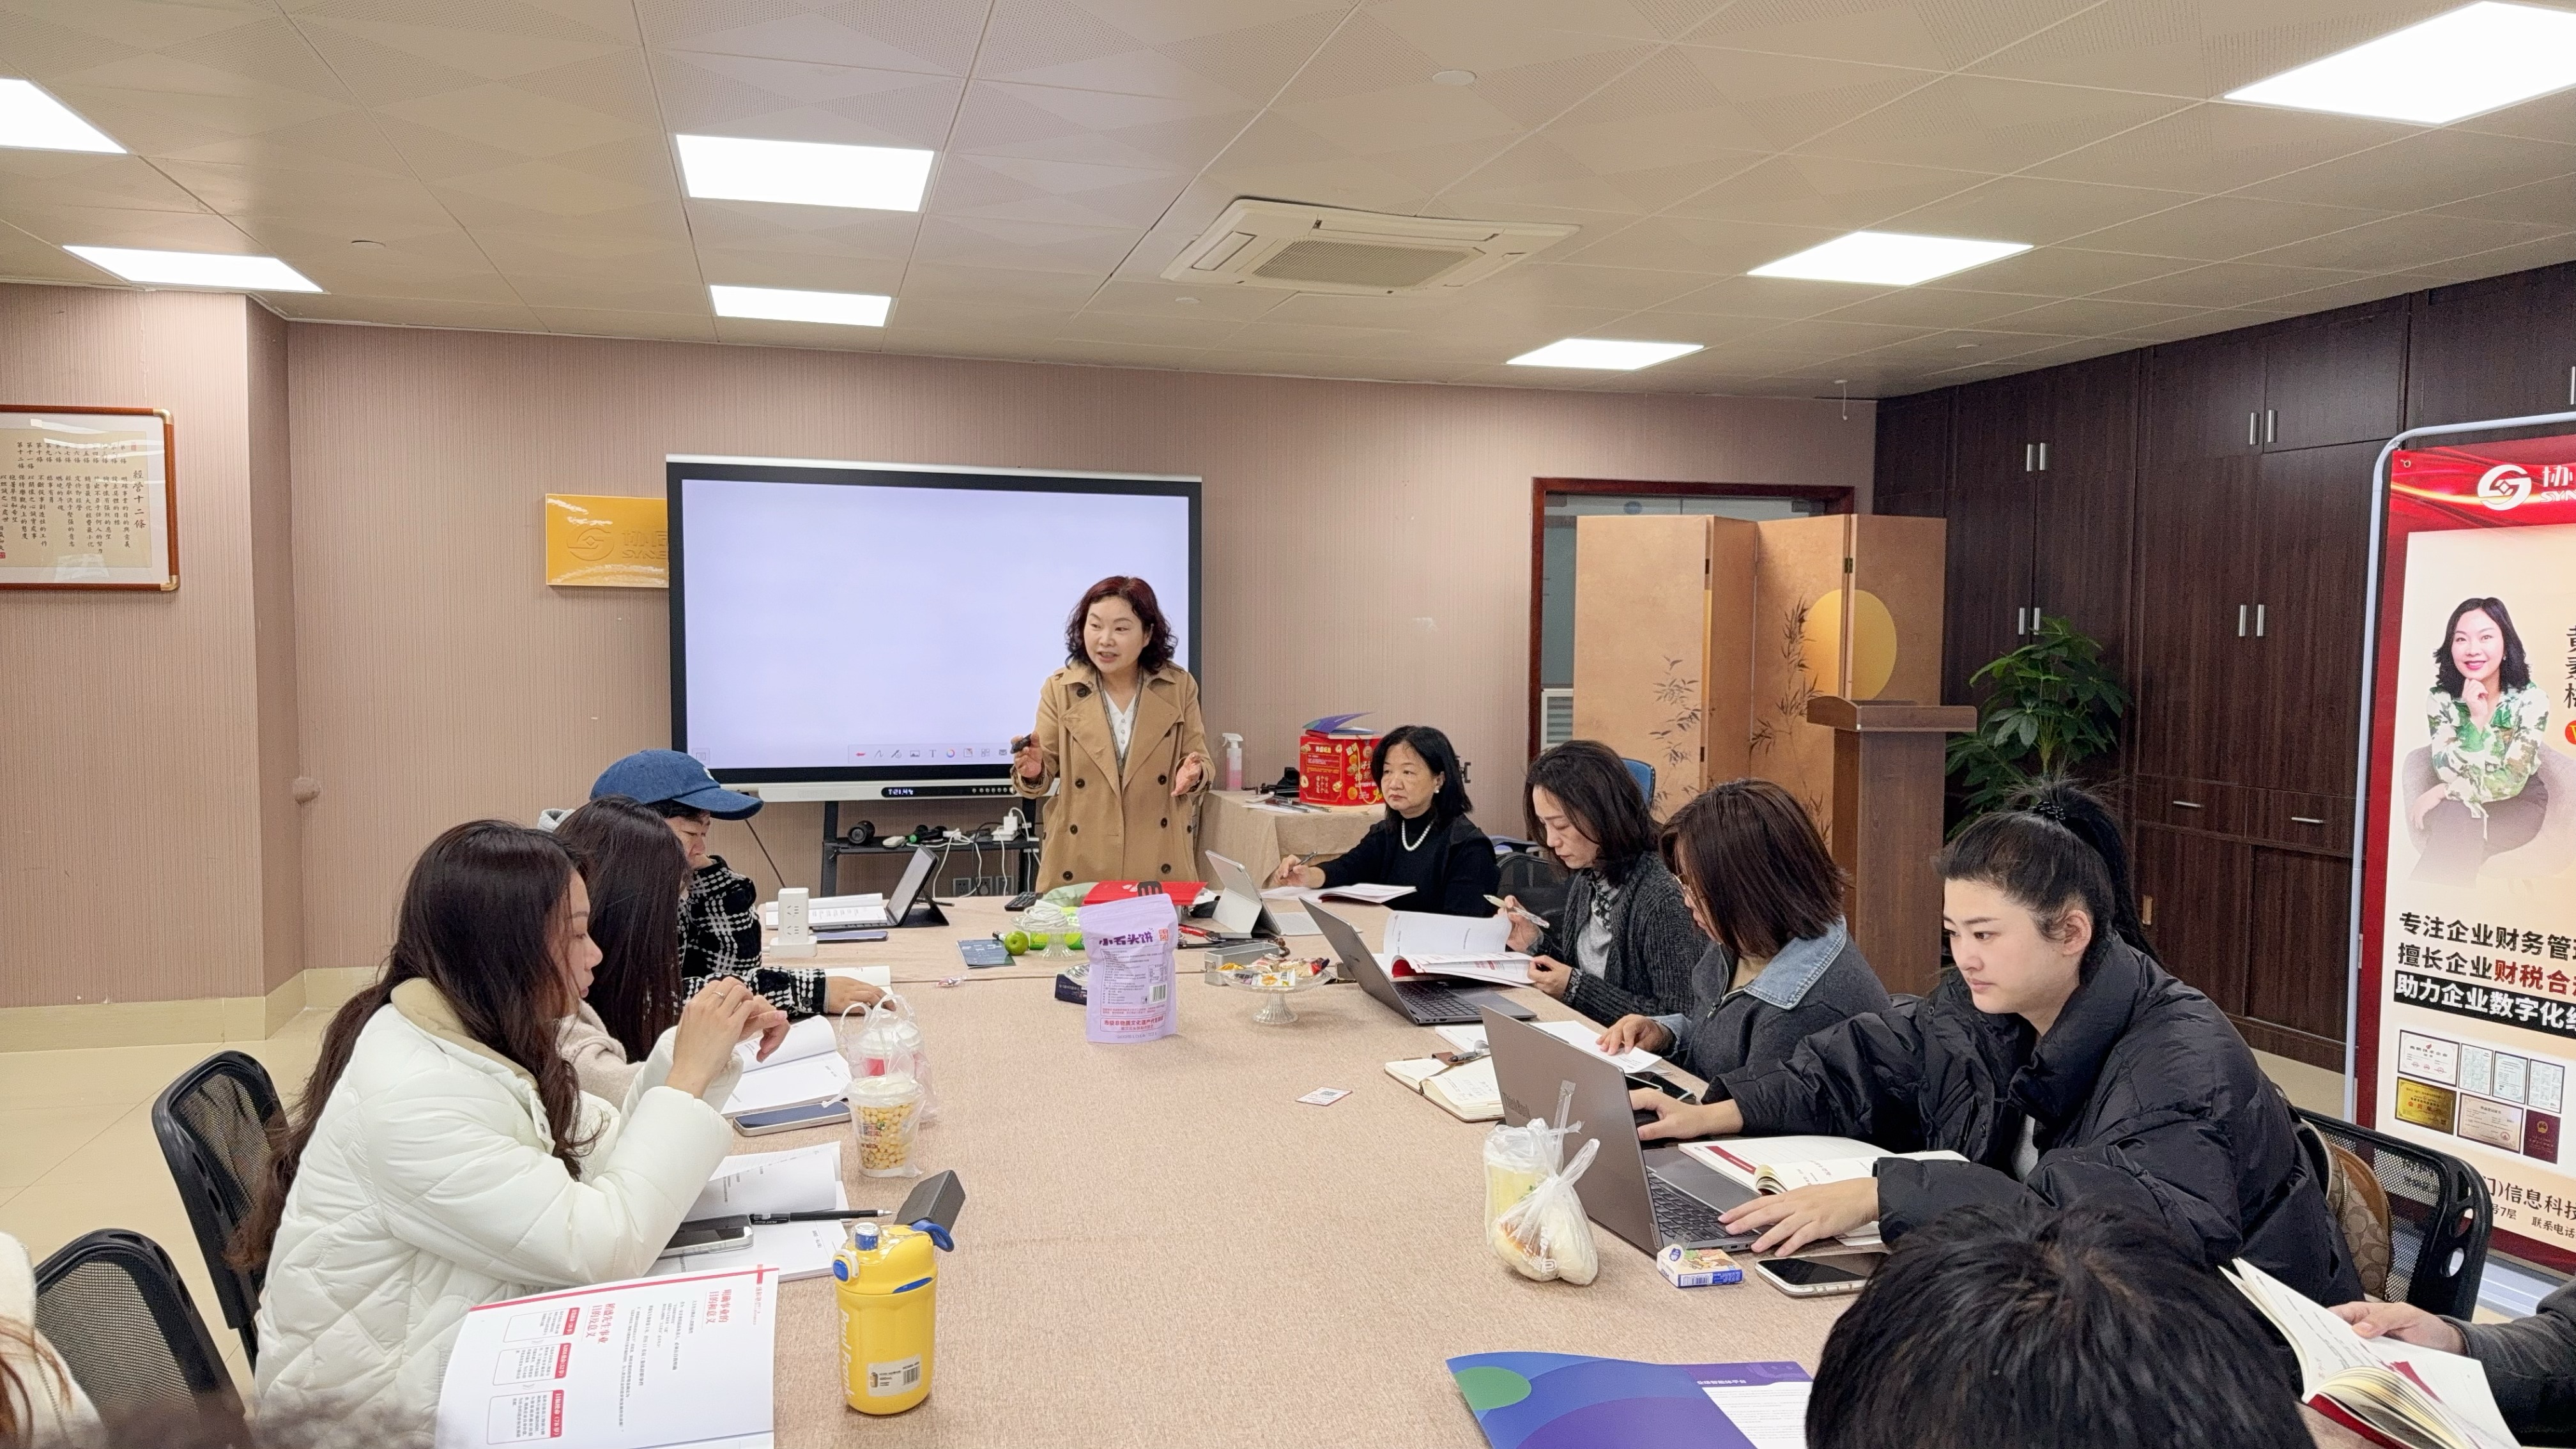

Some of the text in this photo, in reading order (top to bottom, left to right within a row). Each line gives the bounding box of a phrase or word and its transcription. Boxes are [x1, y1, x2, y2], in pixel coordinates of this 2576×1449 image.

[133, 470, 146, 529] 經營十二條
[2542, 464, 2573, 487] 协
[1099, 931, 1153, 946] 小石头饼
[2399, 912, 2576, 962] 专注企业财务管
[2398, 942, 2576, 996] 擅长企业财税合
[840, 1308, 855, 1398] Paul Frank
